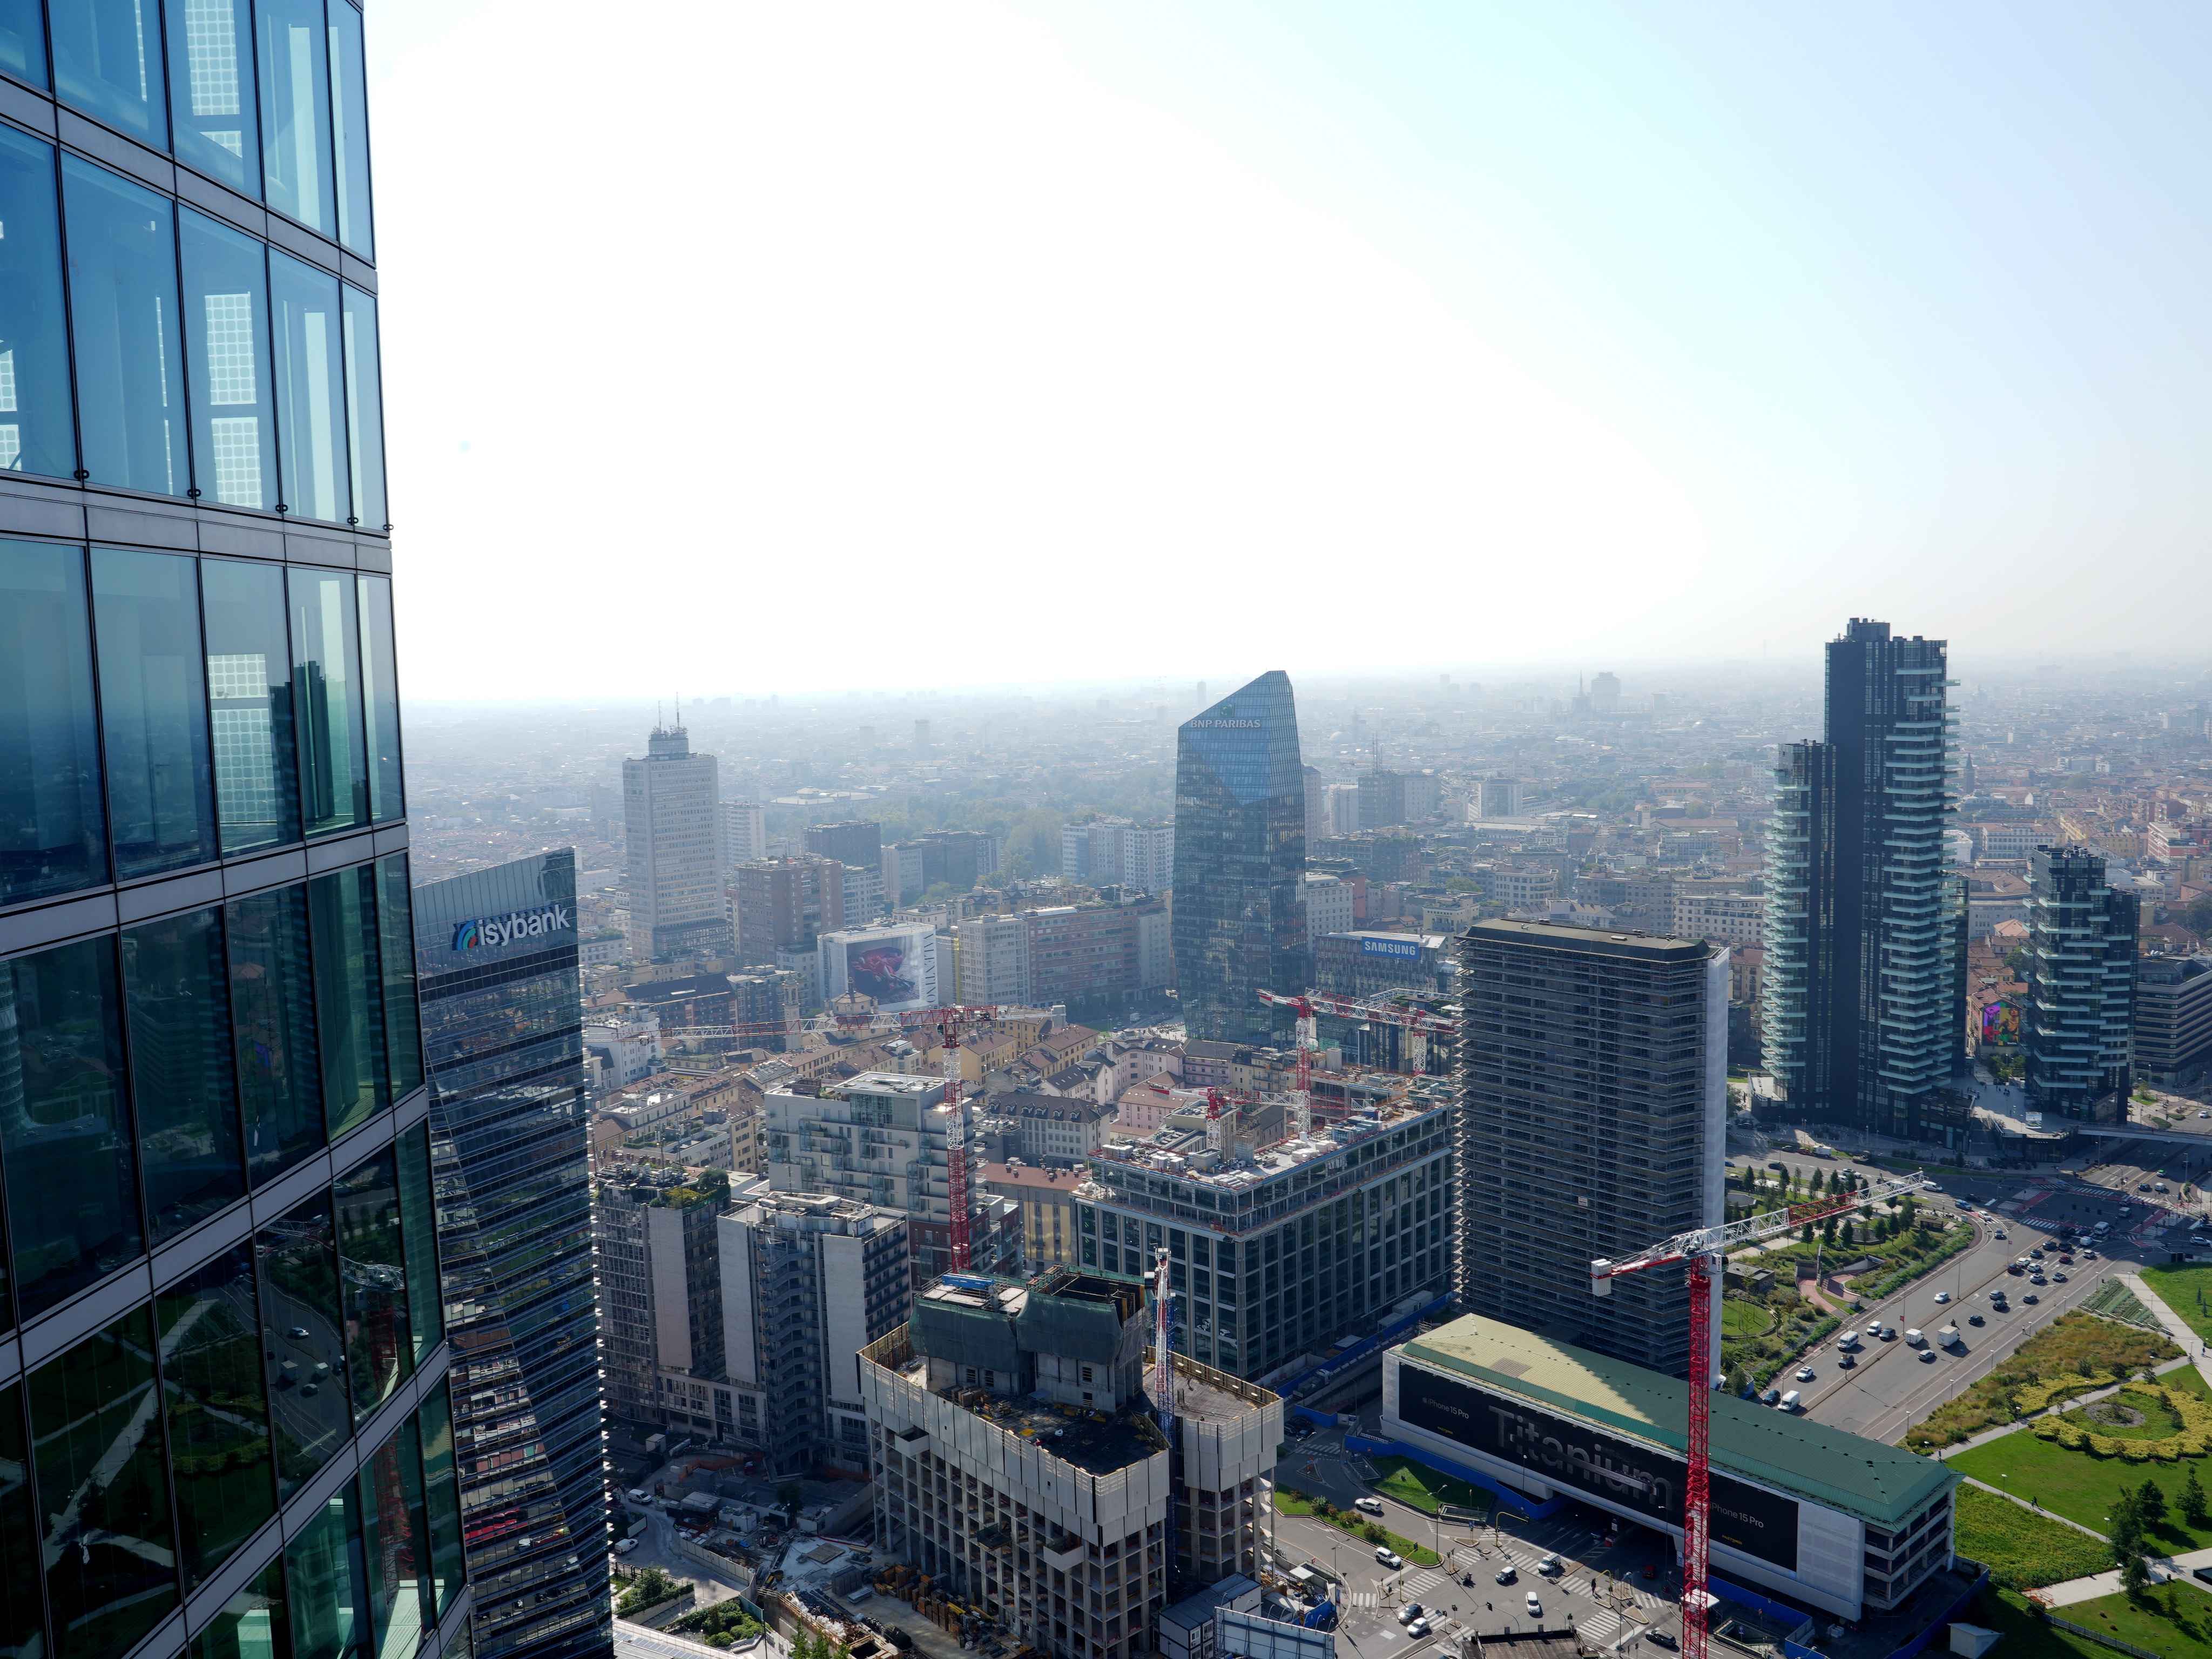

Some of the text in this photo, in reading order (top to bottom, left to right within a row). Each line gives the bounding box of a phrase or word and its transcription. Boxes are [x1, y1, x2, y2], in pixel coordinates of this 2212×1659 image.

[1191, 719, 1260, 728] BNP PARIBAS
[479, 904, 570, 946] isybank
[1365, 941, 1416, 955] SAMSUNG
[924, 934, 936, 1002] VALENTINO
[1427, 1399, 1469, 1419] iPhone 15 Pro
[1488, 1405, 1673, 1510] Titanium
[1739, 1513, 1749, 1522] 15
[1749, 1516, 1764, 1528] Pro
